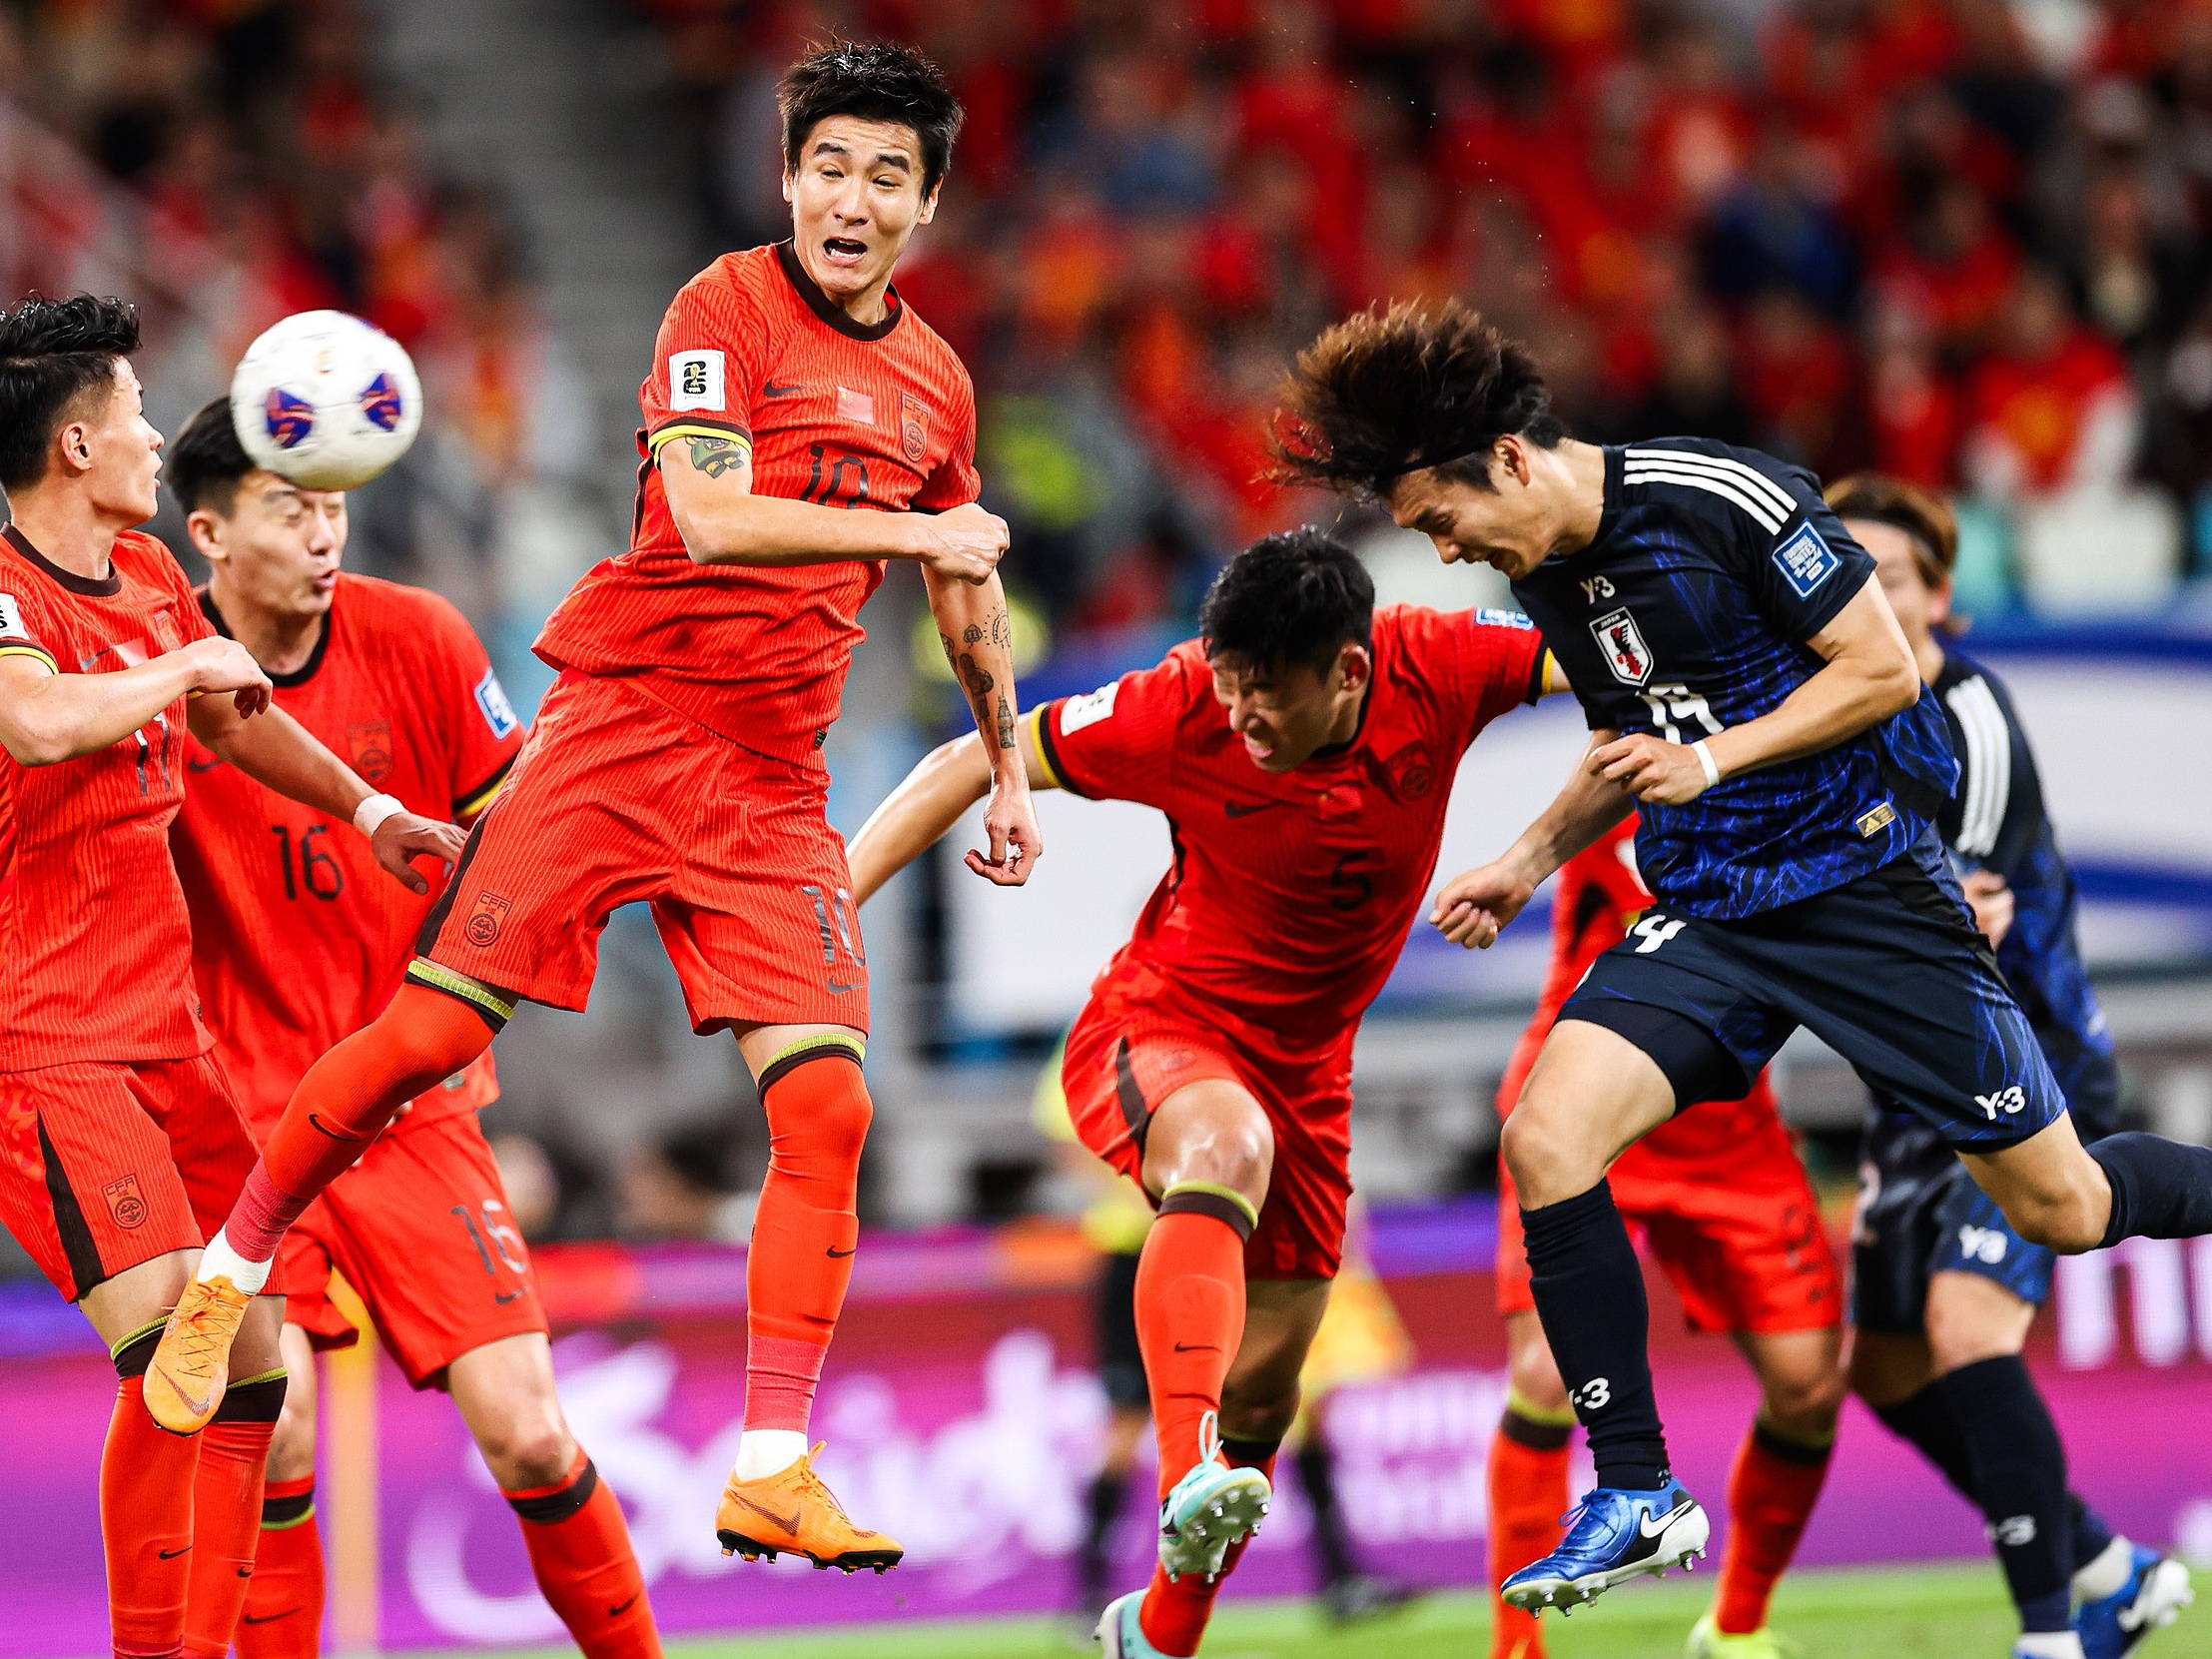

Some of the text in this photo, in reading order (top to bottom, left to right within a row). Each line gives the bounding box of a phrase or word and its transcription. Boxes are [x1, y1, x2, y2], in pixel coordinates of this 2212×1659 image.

[1579, 575, 1616, 605] Y-3
[271, 824, 344, 900] 16
[1329, 849, 1372, 912] 5
[479, 893, 508, 913] CFA
[801, 886, 866, 967] 10
[1973, 1085, 2026, 1121] Y-3
[105, 1177, 135, 1197] CFA
[449, 1199, 527, 1275] 16
